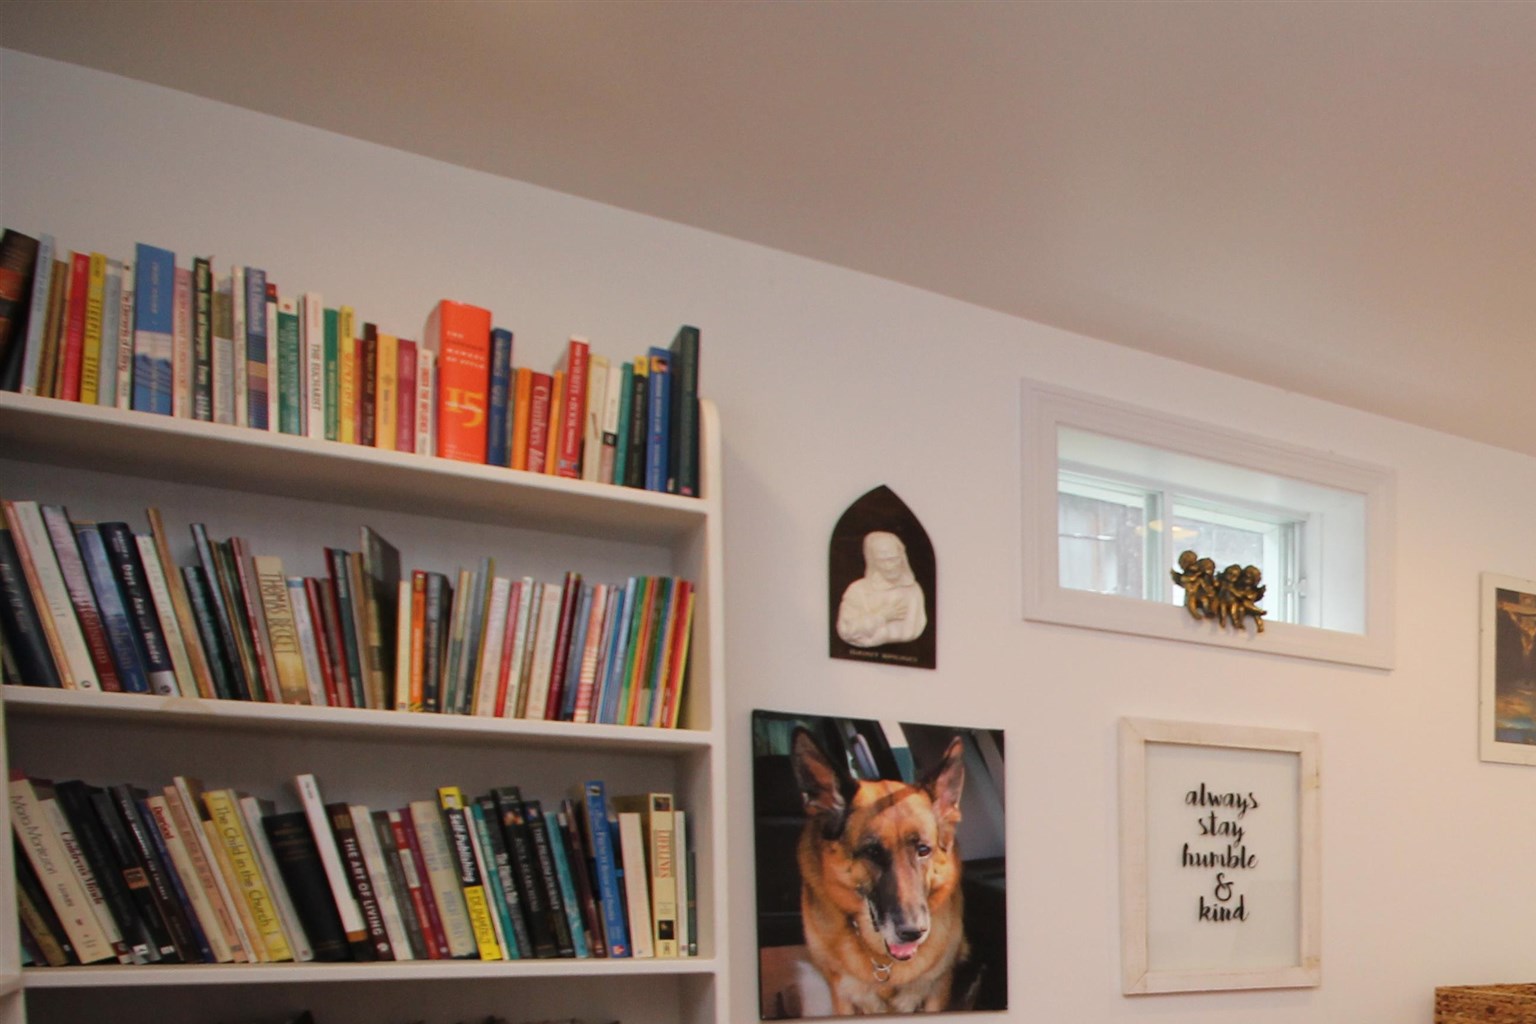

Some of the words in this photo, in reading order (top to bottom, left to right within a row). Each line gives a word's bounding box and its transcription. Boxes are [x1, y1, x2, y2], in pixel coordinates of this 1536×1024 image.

[310, 343, 320, 360] THE
[310, 362, 320, 411] EUCHARIST
[530, 384, 549, 446] Chambers
[260, 572, 289, 617] THOMAS
[121, 564, 136, 586] Days
[144, 632, 163, 664] Wonder
[214, 804, 232, 826] The
[1185, 783, 1260, 819] always
[223, 827, 245, 856] Child
[1198, 811, 1246, 848] stay
[344, 837, 359, 857] THE
[448, 813, 476, 884] Self-Publishing
[1181, 843, 1259, 869] humble
[241, 868, 256, 887] the
[350, 859, 365, 880] ART
[356, 883, 370, 896] OF
[520, 862, 539, 912] SEARCHING
[1214, 872, 1234, 902] &
[248, 889, 272, 927] Church
[362, 900, 383, 936] LIVING
[1198, 894, 1250, 922] kind
